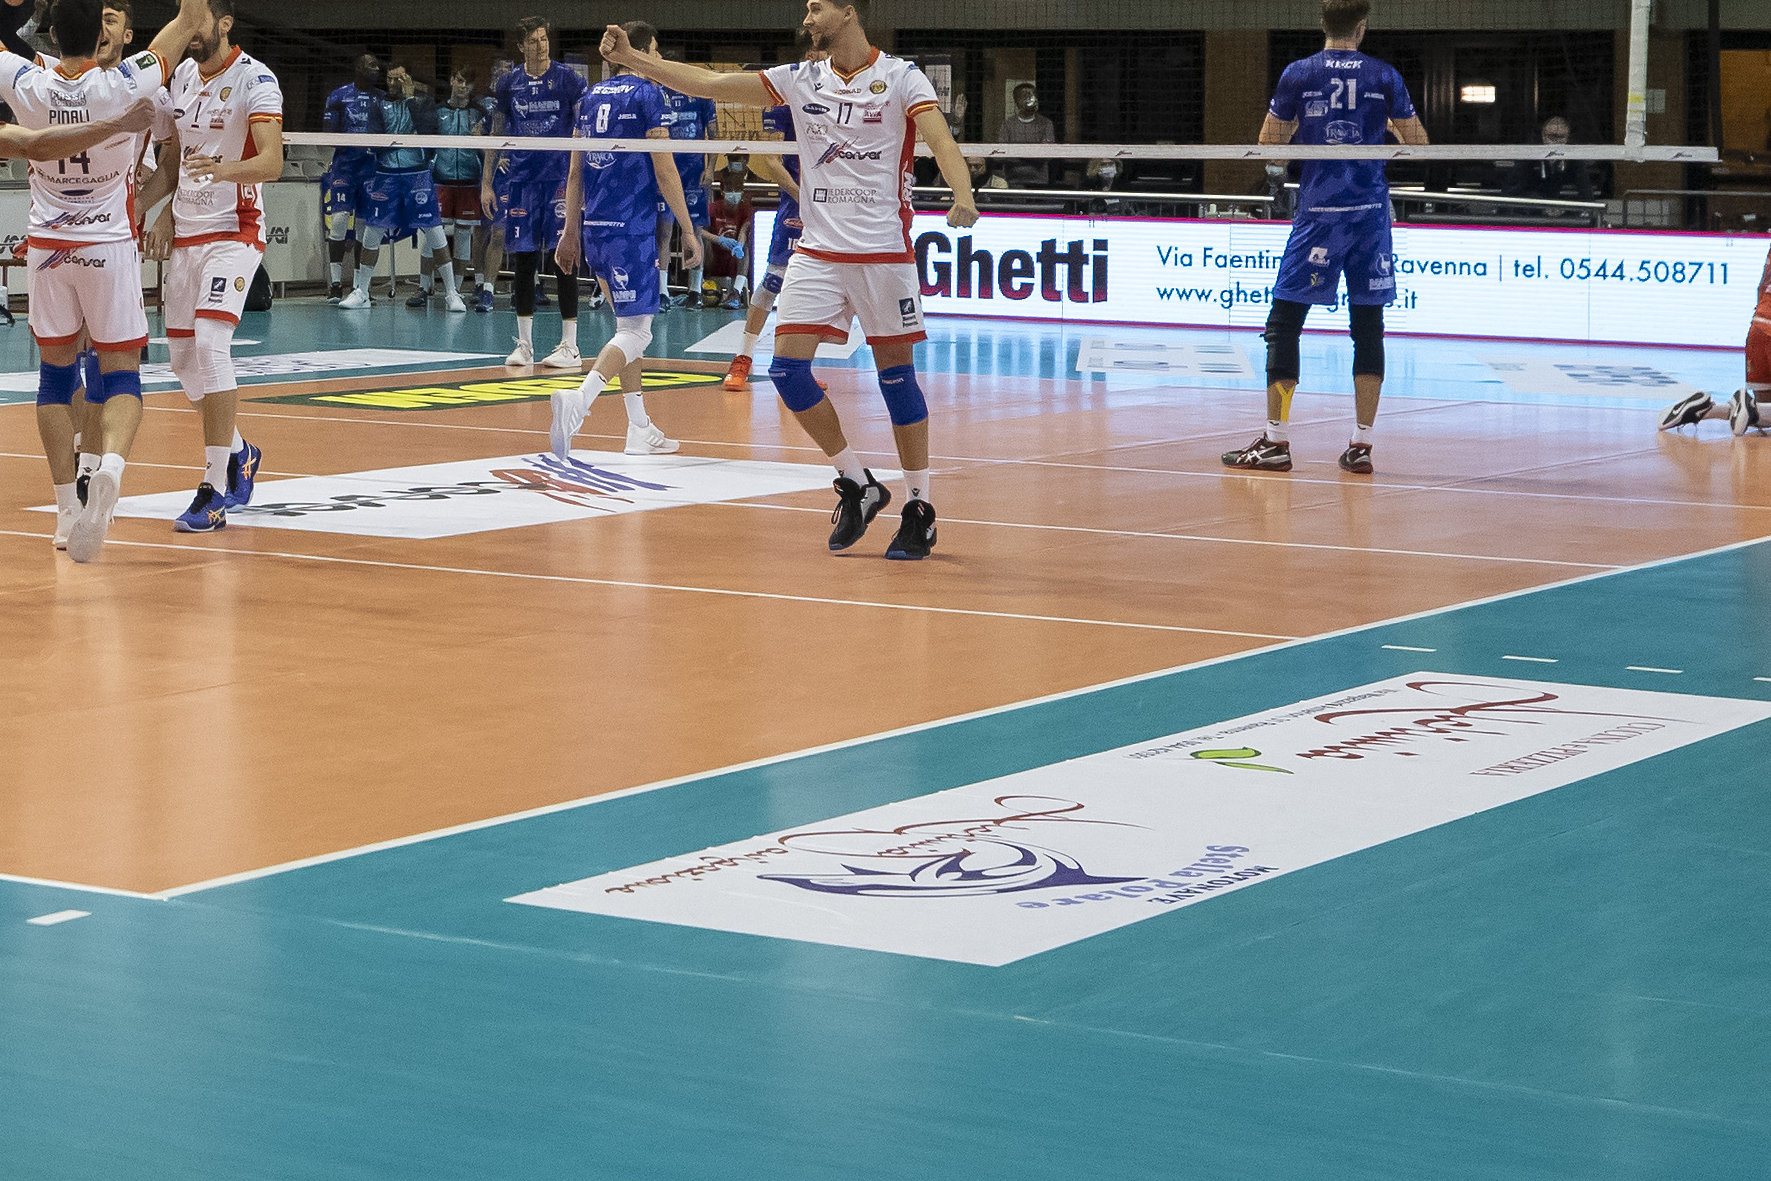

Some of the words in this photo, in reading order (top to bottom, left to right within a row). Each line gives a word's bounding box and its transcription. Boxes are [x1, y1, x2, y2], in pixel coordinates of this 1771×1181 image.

[1330, 77, 1357, 110] 21
[49, 109, 90, 124] PINALI
[596, 103, 611, 134] 8
[836, 103, 853, 125] 17
[47, 170, 121, 185] MARCEGAGLIA
[914, 231, 1109, 304] Ghetti
[1156, 244, 1193, 268] Via
[1203, 247, 1285, 270] Faentin
[1513, 255, 1549, 280] tel.
[1560, 257, 1729, 285] 0544.508711
[1571, 721, 1666, 745] CUCINA
[1469, 747, 1589, 777] PIZZERIA
[1168, 845, 1250, 879] Stella
[1147, 866, 1280, 906] MOTONAVE
